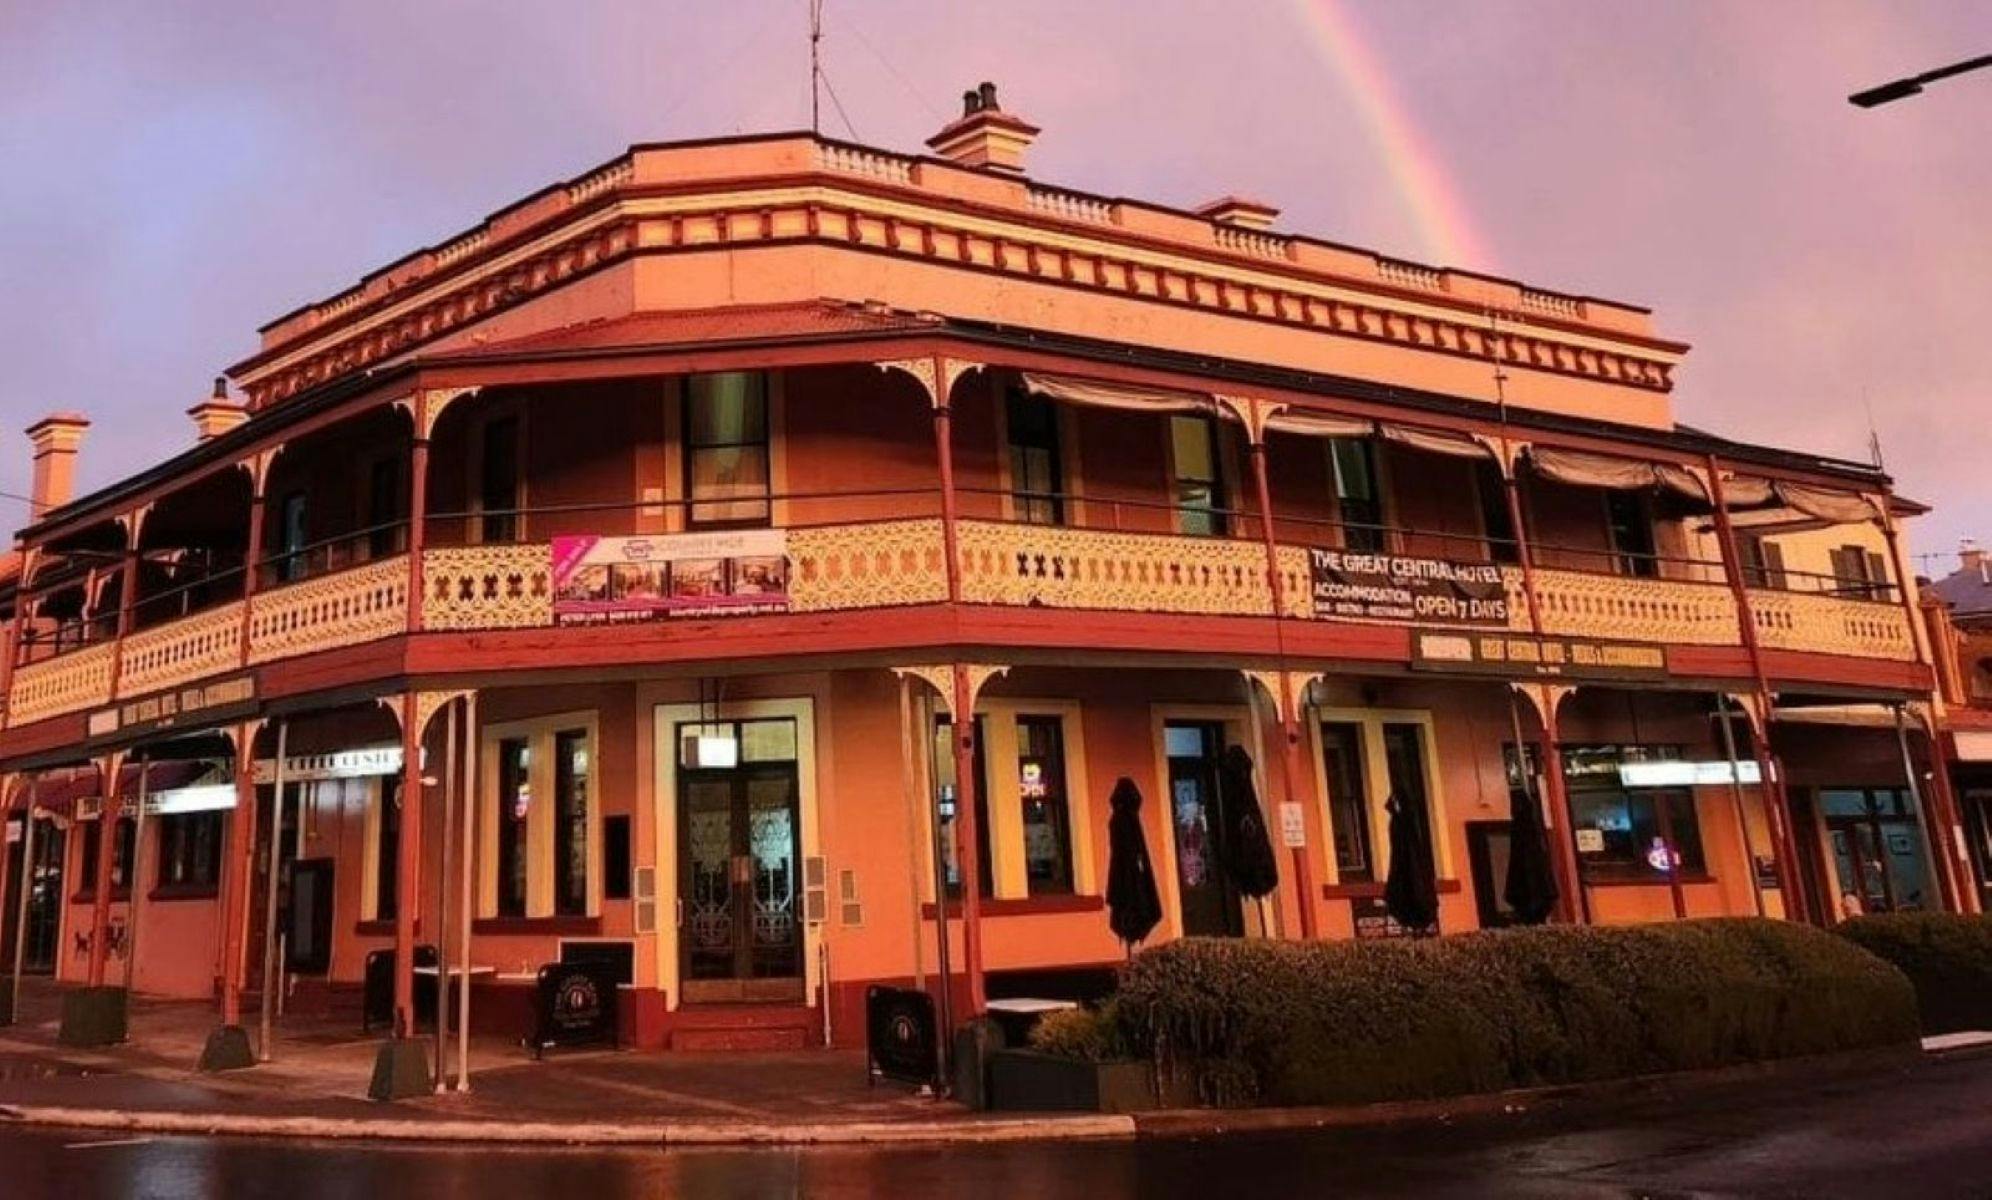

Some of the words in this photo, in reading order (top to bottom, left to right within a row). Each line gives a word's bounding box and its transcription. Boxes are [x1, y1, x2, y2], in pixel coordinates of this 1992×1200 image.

[1312, 549, 1343, 571] THE
[1343, 554, 1389, 574] GREAT
[1392, 557, 1455, 580] CENTRAL
[1455, 562, 1503, 583] HOTEL
[1314, 582, 1411, 603] ACCOMMODATION
[1416, 596, 1457, 616] OPEN
[1457, 600, 1467, 619] 7
[1470, 599, 1506, 618] DAYS
